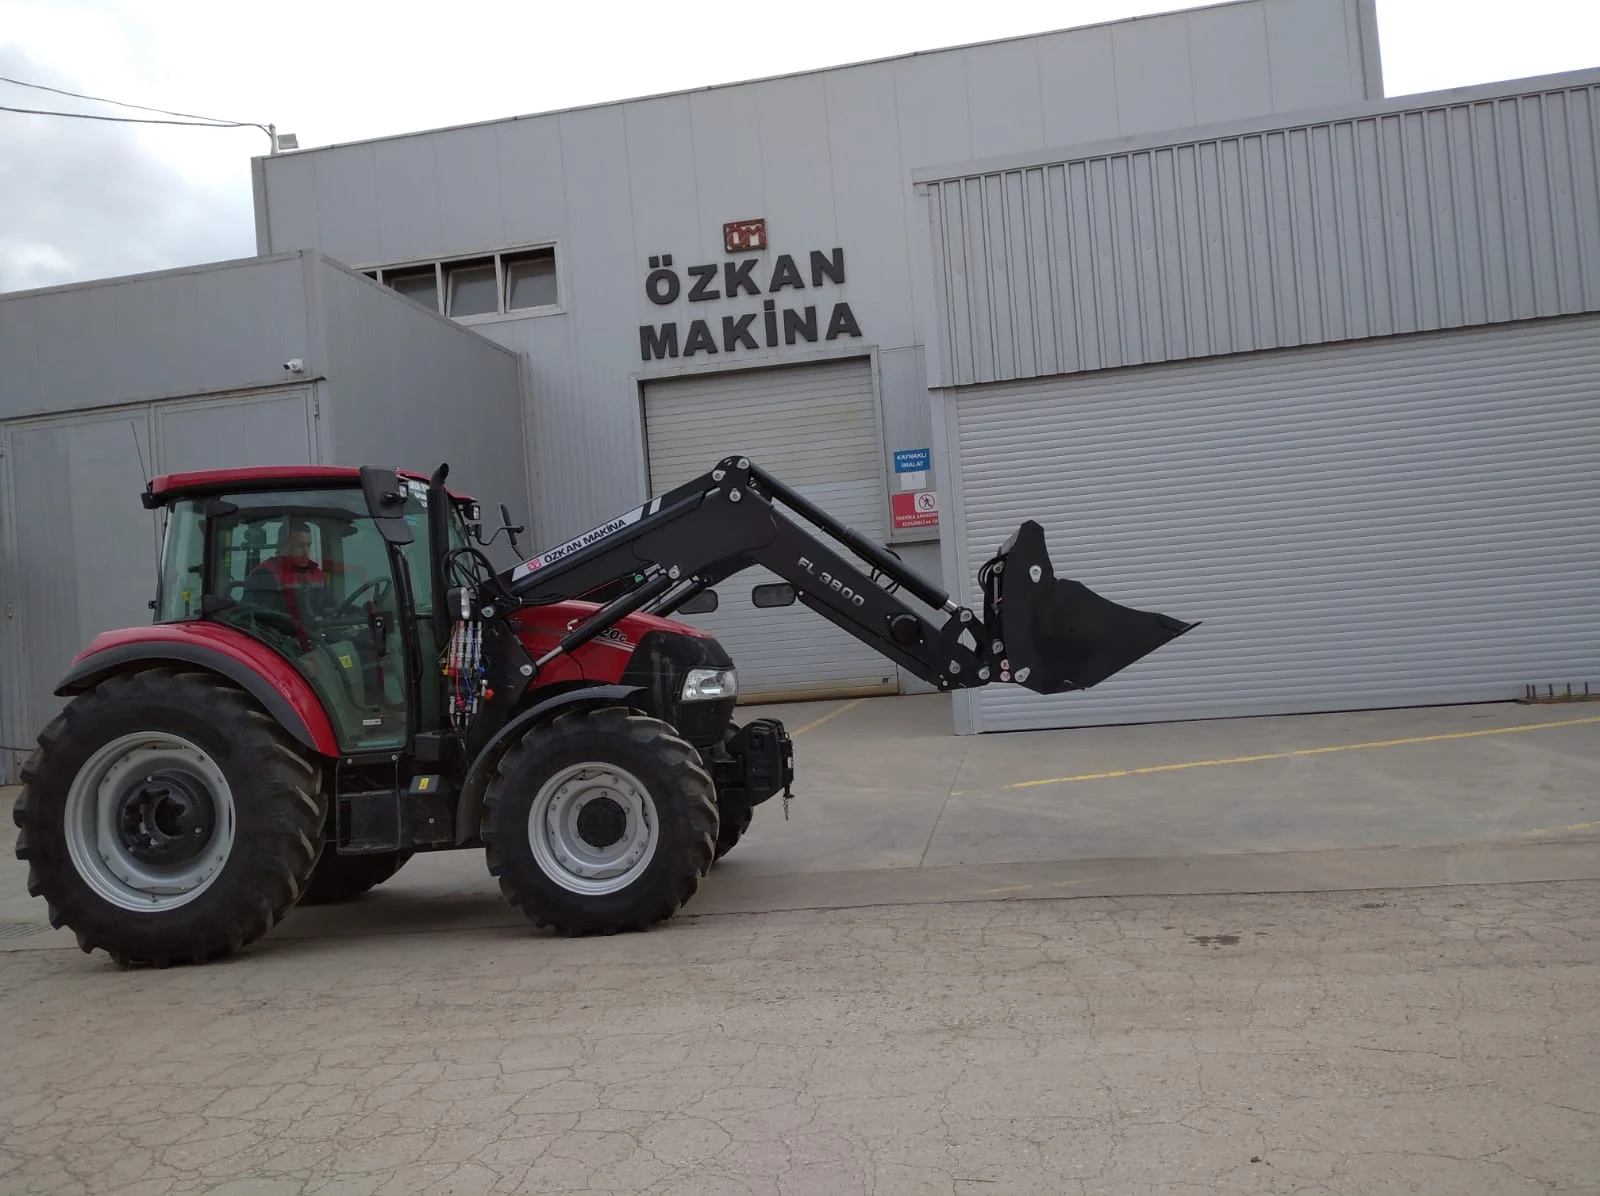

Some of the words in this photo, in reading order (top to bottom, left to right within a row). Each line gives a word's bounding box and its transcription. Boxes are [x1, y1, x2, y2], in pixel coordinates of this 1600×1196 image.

[645, 247, 846, 305] ÖZKAN
[639, 299, 863, 361] MAKİNA
[797, 556, 815, 575] FL
[819, 571, 865, 607] 3800
